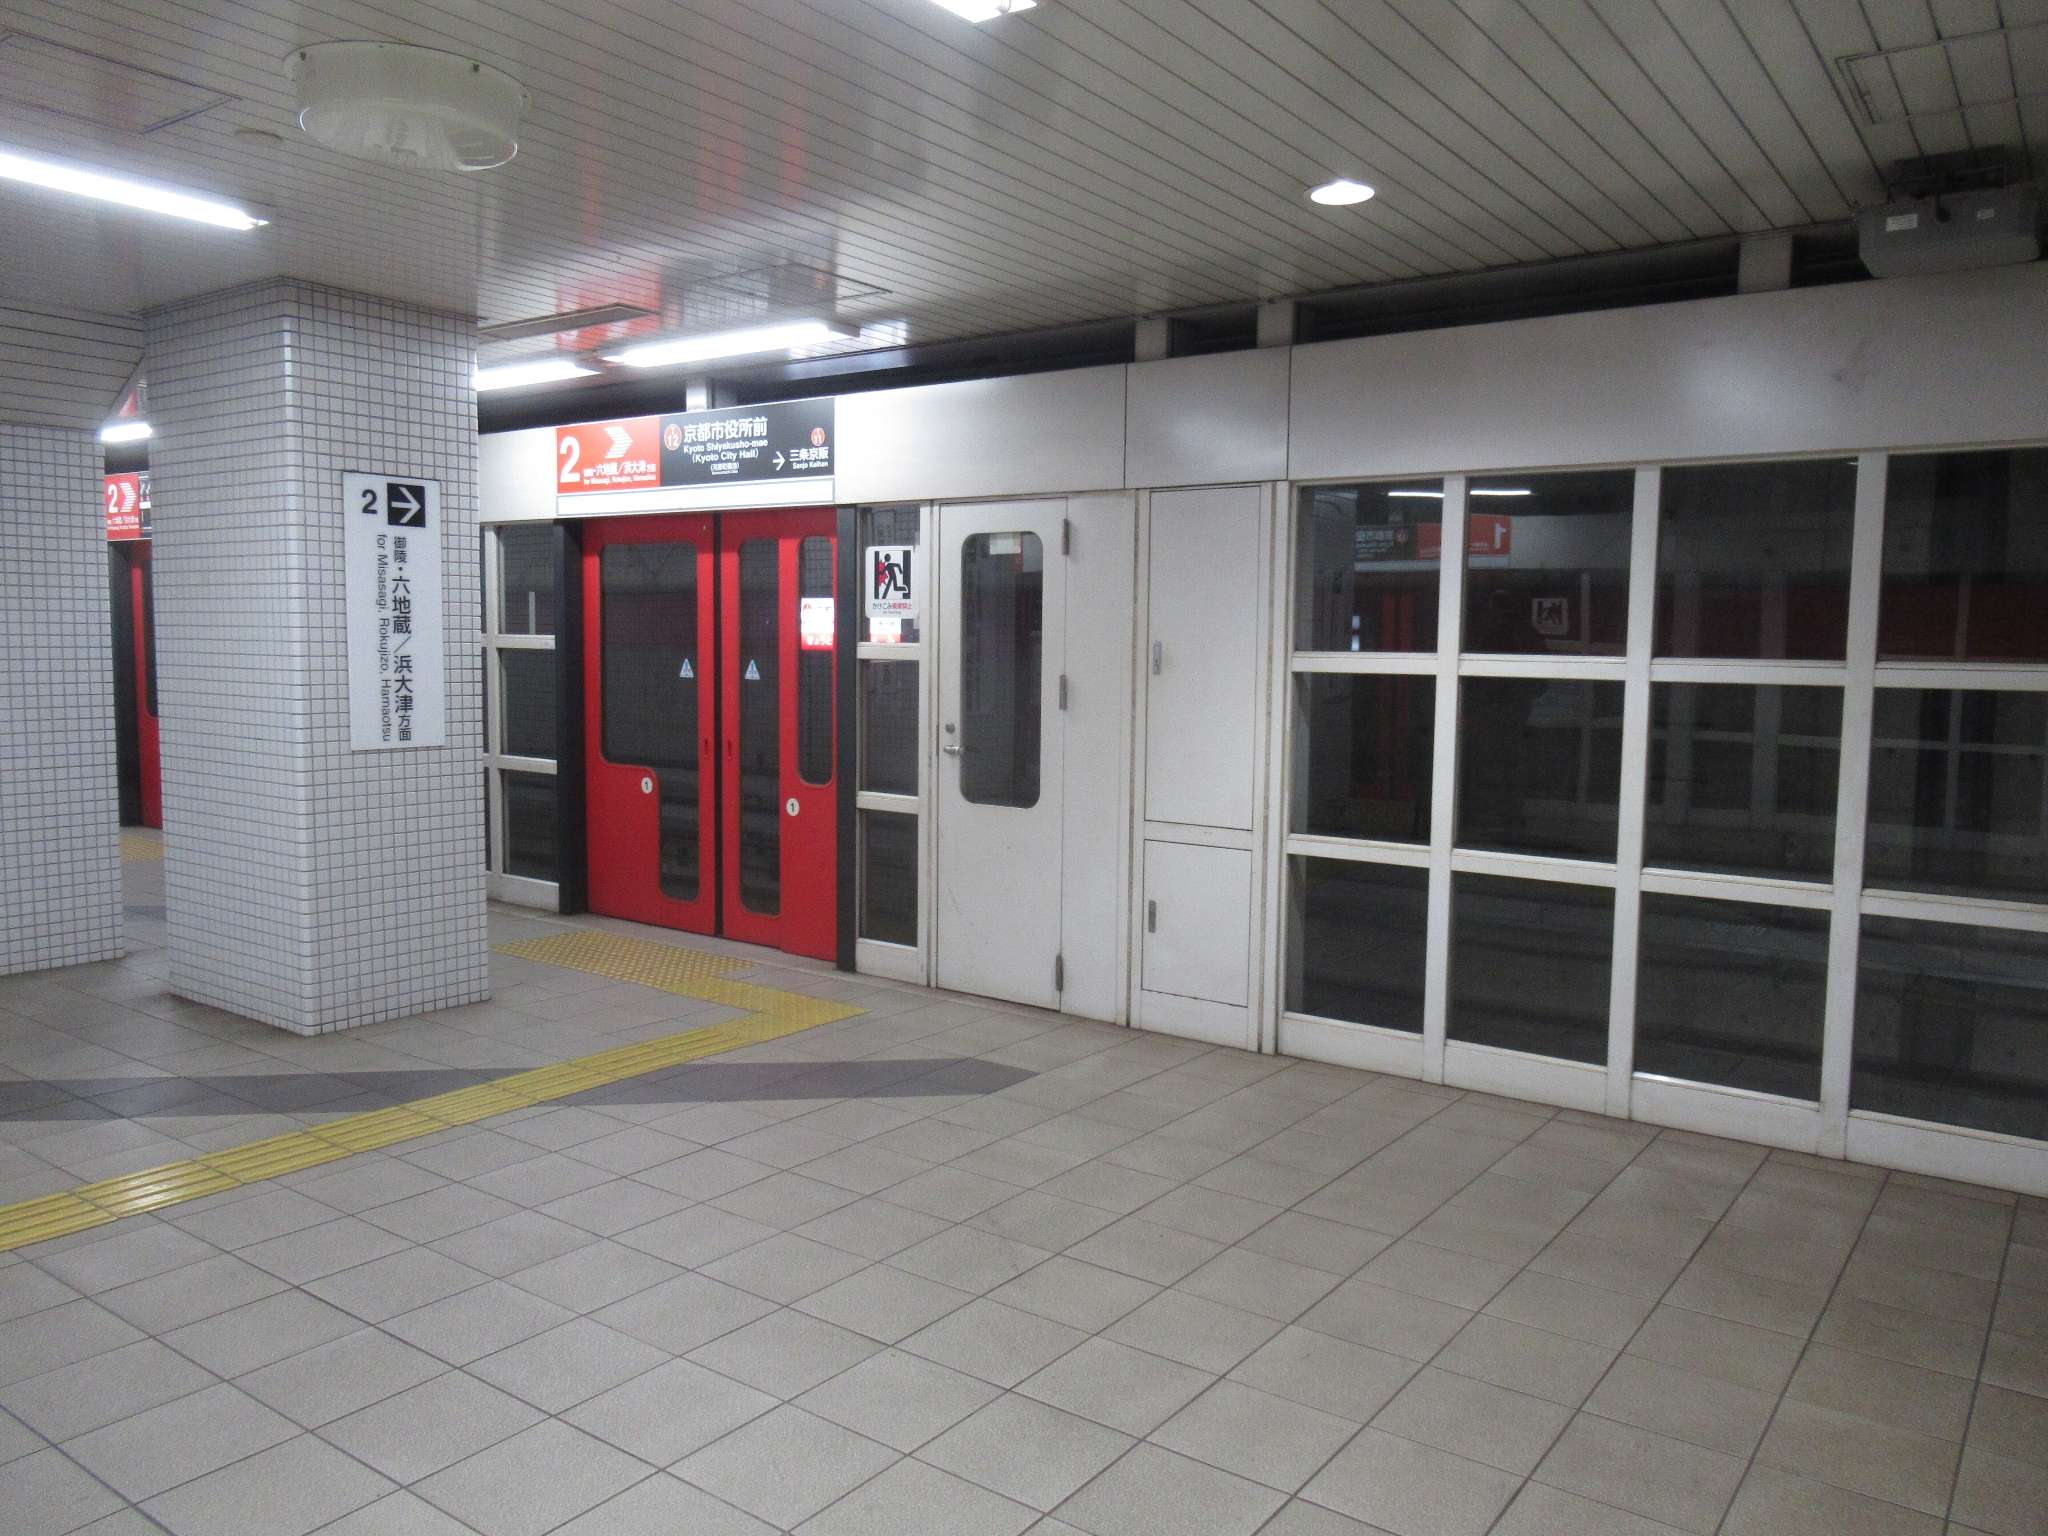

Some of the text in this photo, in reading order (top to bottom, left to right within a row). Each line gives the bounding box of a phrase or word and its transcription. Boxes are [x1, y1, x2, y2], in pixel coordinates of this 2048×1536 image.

[683, 417, 768, 443] 京都市役所前
[559, 436, 581, 483] 2
[683, 439, 769, 455] Kyoto Shiyakusho-mae
[692, 448, 759, 464] (Kyoto City Hall)
[789, 447, 829, 462] 三条京阪
[107, 483, 119, 513] 2
[361, 488, 378, 514] 2
[376, 534, 388, 550] for
[380, 679, 392, 742] Hamaotsu
